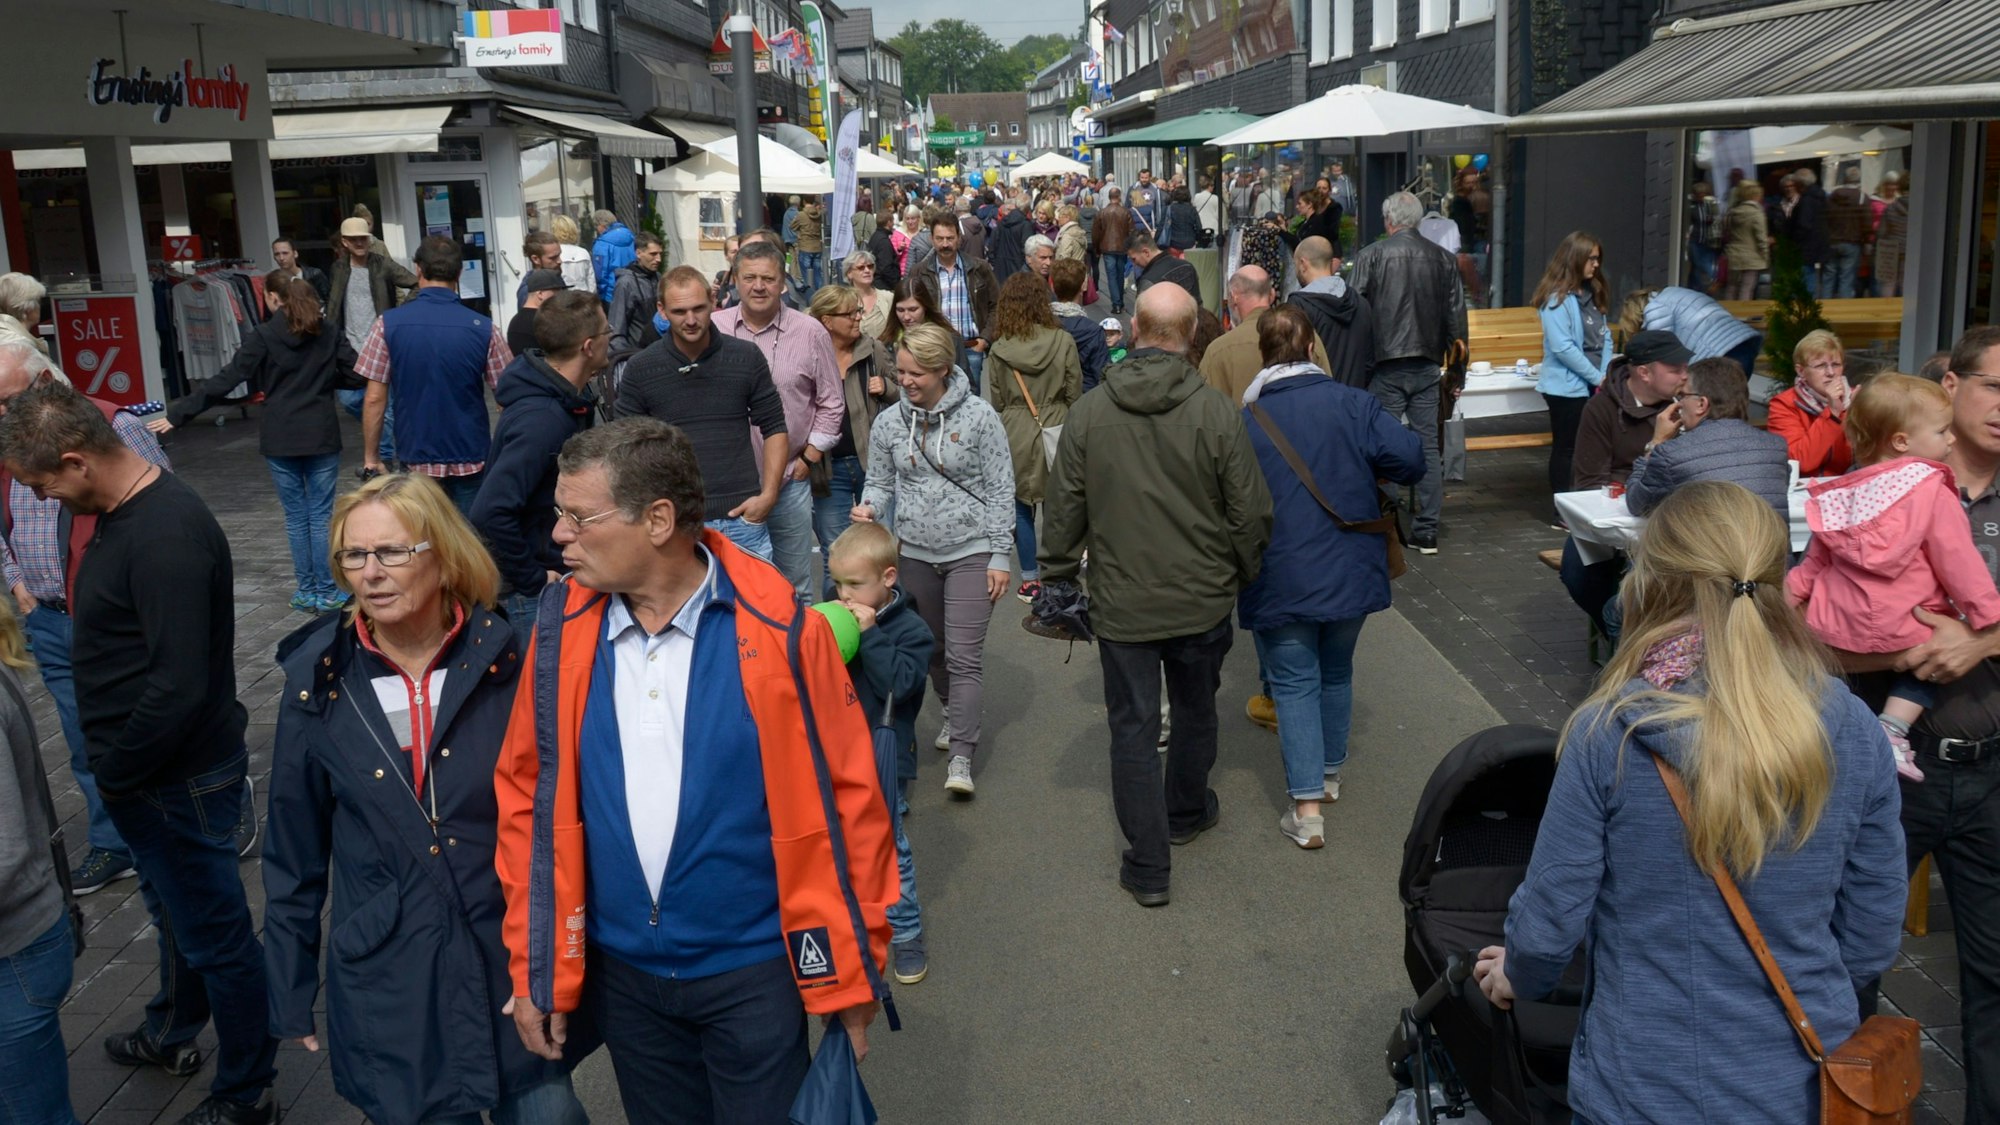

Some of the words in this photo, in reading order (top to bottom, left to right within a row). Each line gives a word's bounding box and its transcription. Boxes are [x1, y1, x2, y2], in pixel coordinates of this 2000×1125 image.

[475, 46, 517, 59] Ernsting's
[519, 43, 553, 56] family
[90, 57, 184, 124] Ernsting's
[183, 58, 250, 122] family
[72, 317, 123, 341] SALE
